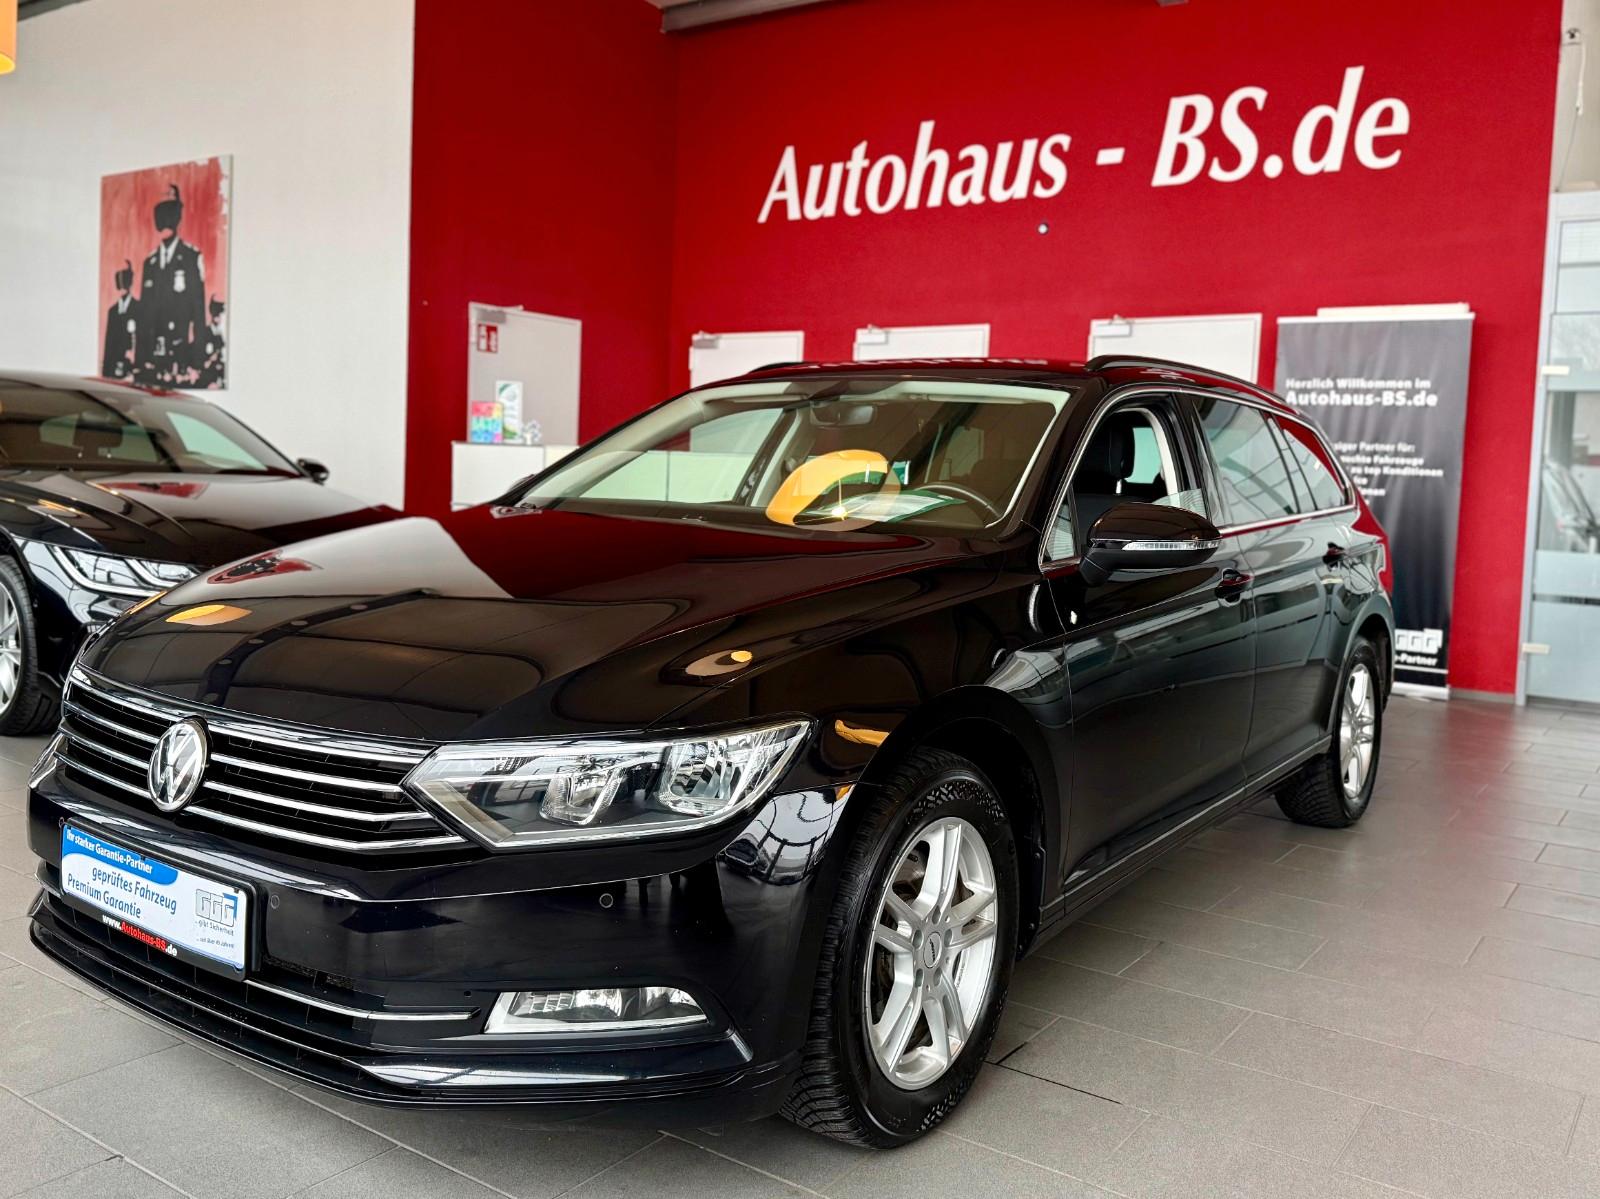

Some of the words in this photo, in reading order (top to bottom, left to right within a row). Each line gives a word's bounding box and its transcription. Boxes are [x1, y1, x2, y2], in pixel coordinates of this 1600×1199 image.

[757, 119, 1072, 224] Autohaus
[1150, 65, 1411, 188] BS.de
[1286, 378, 1333, 390] Herzlich
[1337, 378, 1412, 389] Willkommen
[1415, 378, 1431, 389] im
[1286, 391, 1438, 406] Autohaus-BS.de
[1360, 442, 1396, 452] Partner
[1374, 455, 1424, 466] Fahrzeuge
[1350, 466, 1363, 475] zu
[1364, 465, 1381, 477] top
[1383, 466, 1444, 477] Konditionen
[75, 834, 96, 852] starker
[95, 843, 153, 875] Garantie-Partner
[67, 873, 102, 902] Premium
[103, 890, 142, 919] Garantie
[92, 867, 133, 893] geprüftes
[134, 881, 177, 916] Fahrzeug
[102, 915, 178, 957] www.Autohaus-BS.de
